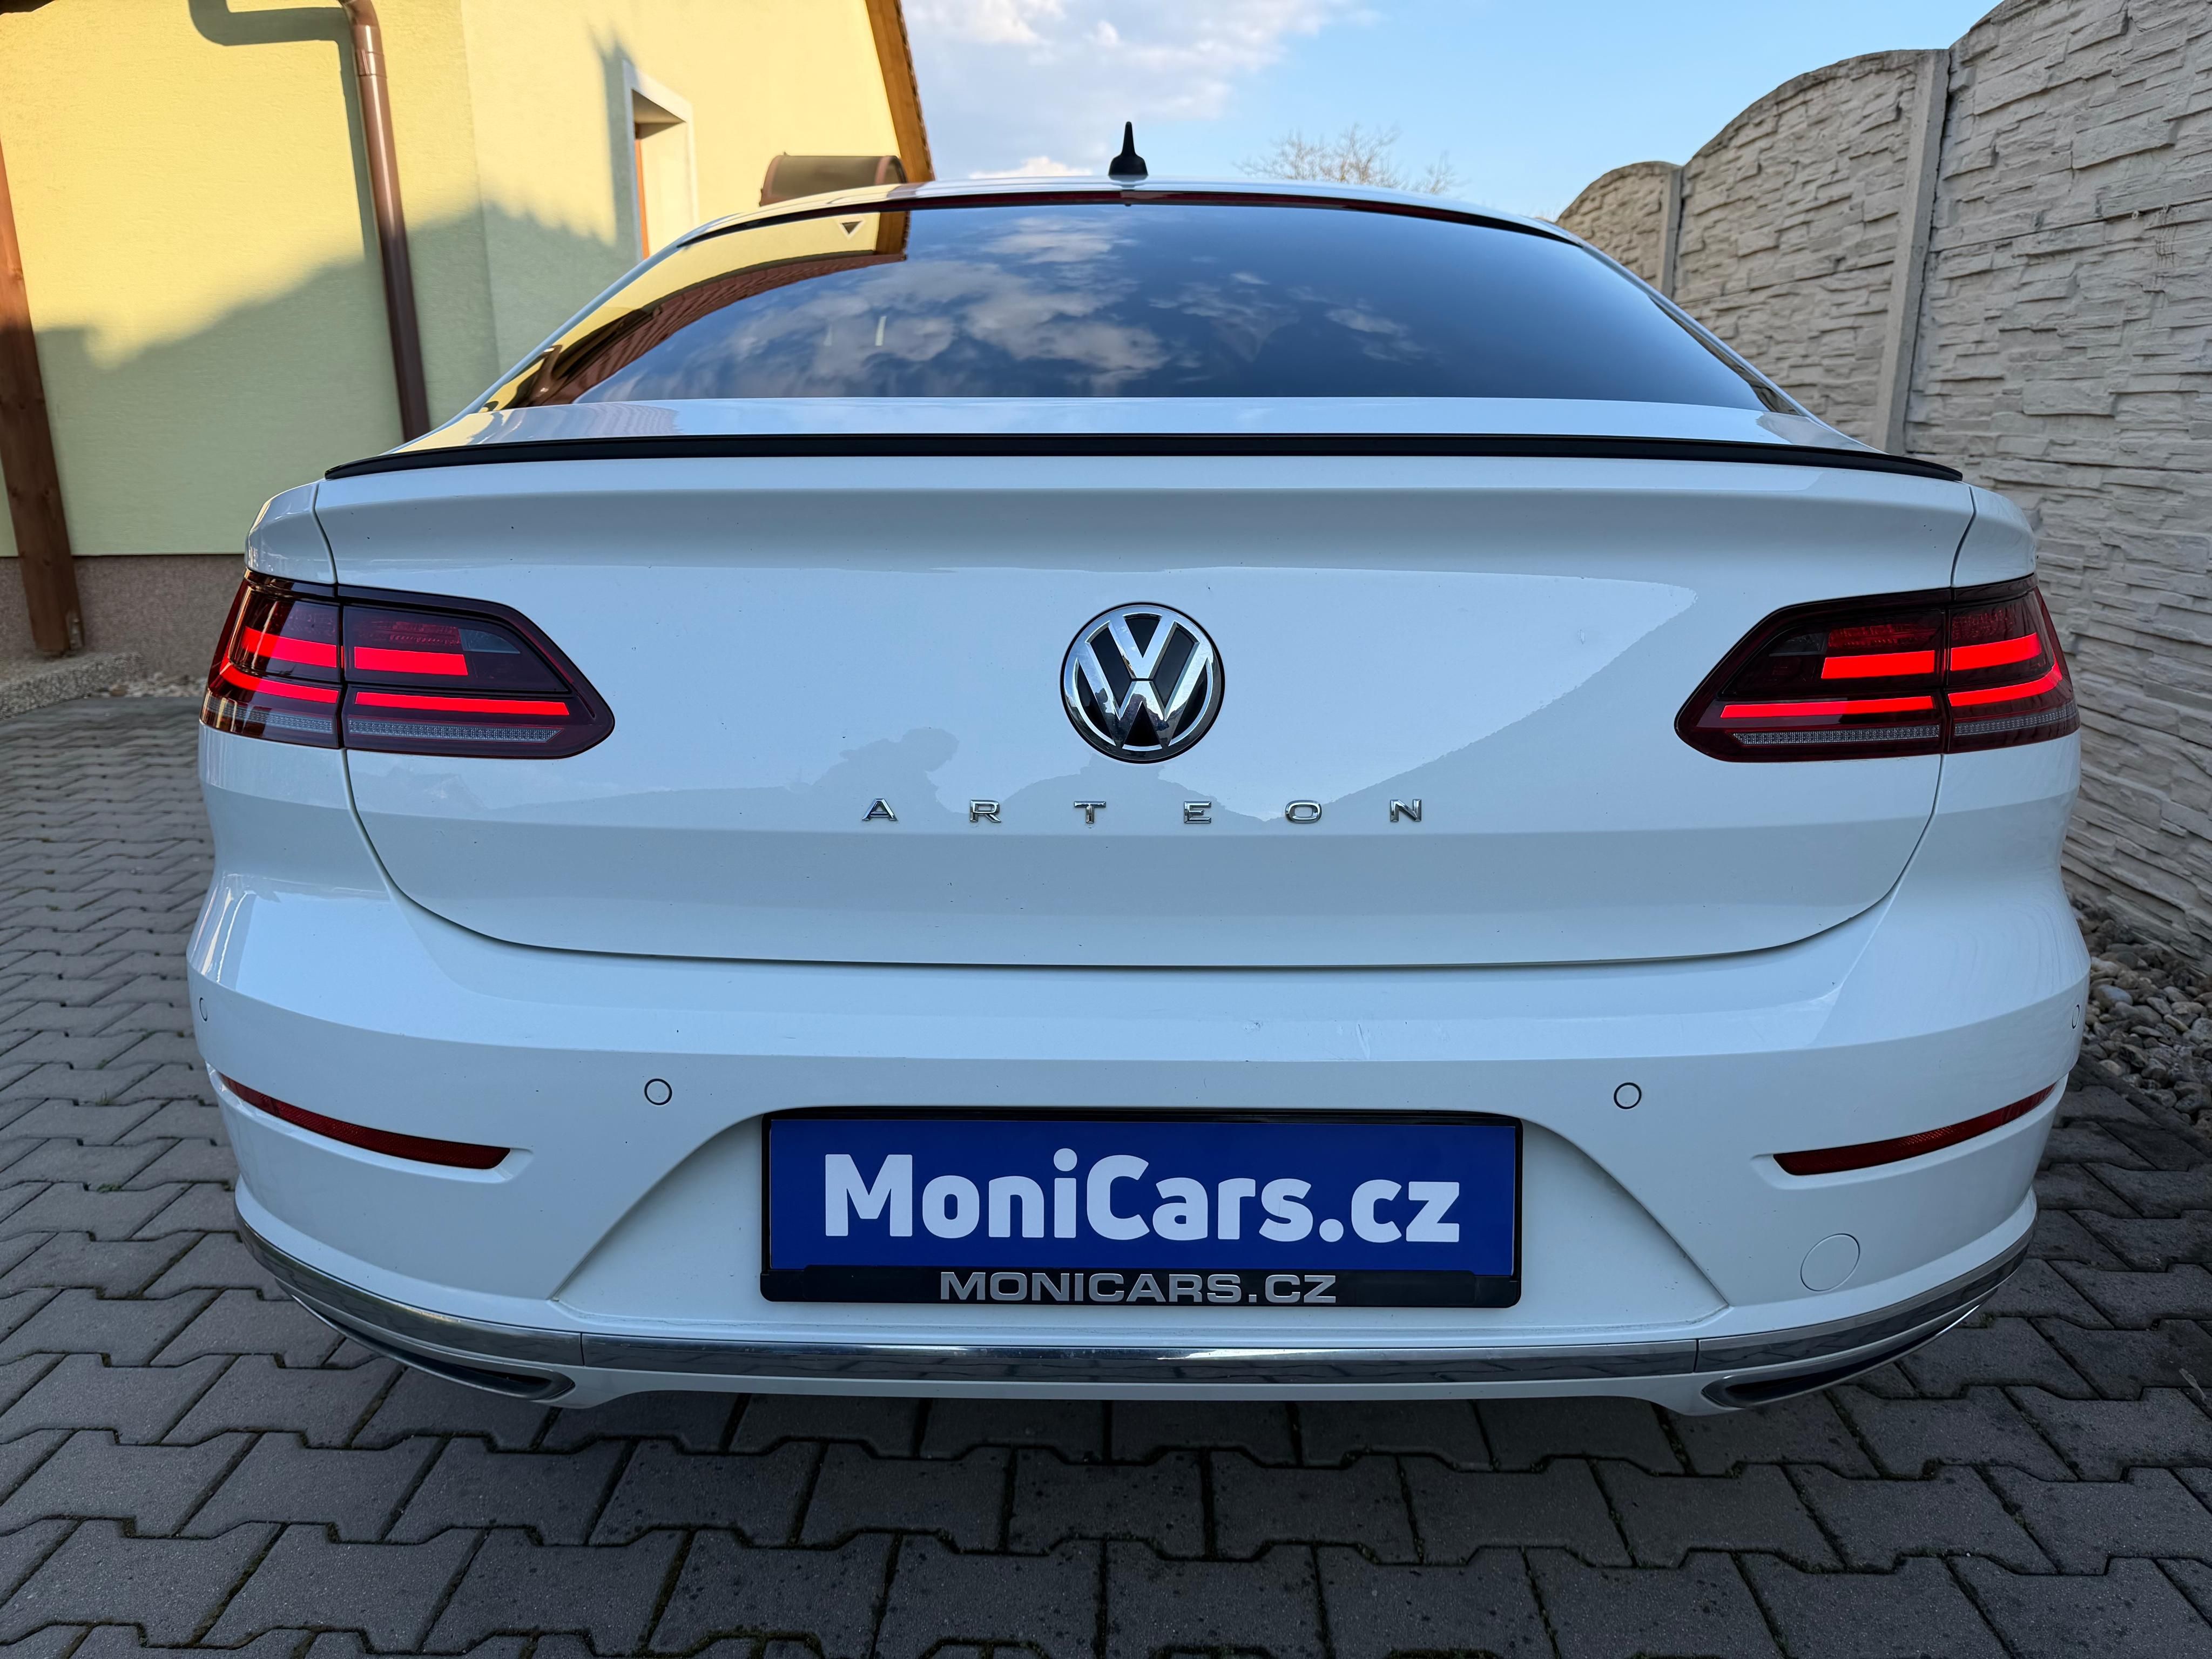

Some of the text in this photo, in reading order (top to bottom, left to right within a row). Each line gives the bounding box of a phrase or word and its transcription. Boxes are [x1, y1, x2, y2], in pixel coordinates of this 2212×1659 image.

[1063, 604, 1222, 759] VW
[861, 797, 1423, 825] ARTEON
[825, 1148, 1460, 1243] MoniCars.cz
[940, 1271, 1337, 1304] MONICARS.CZ
